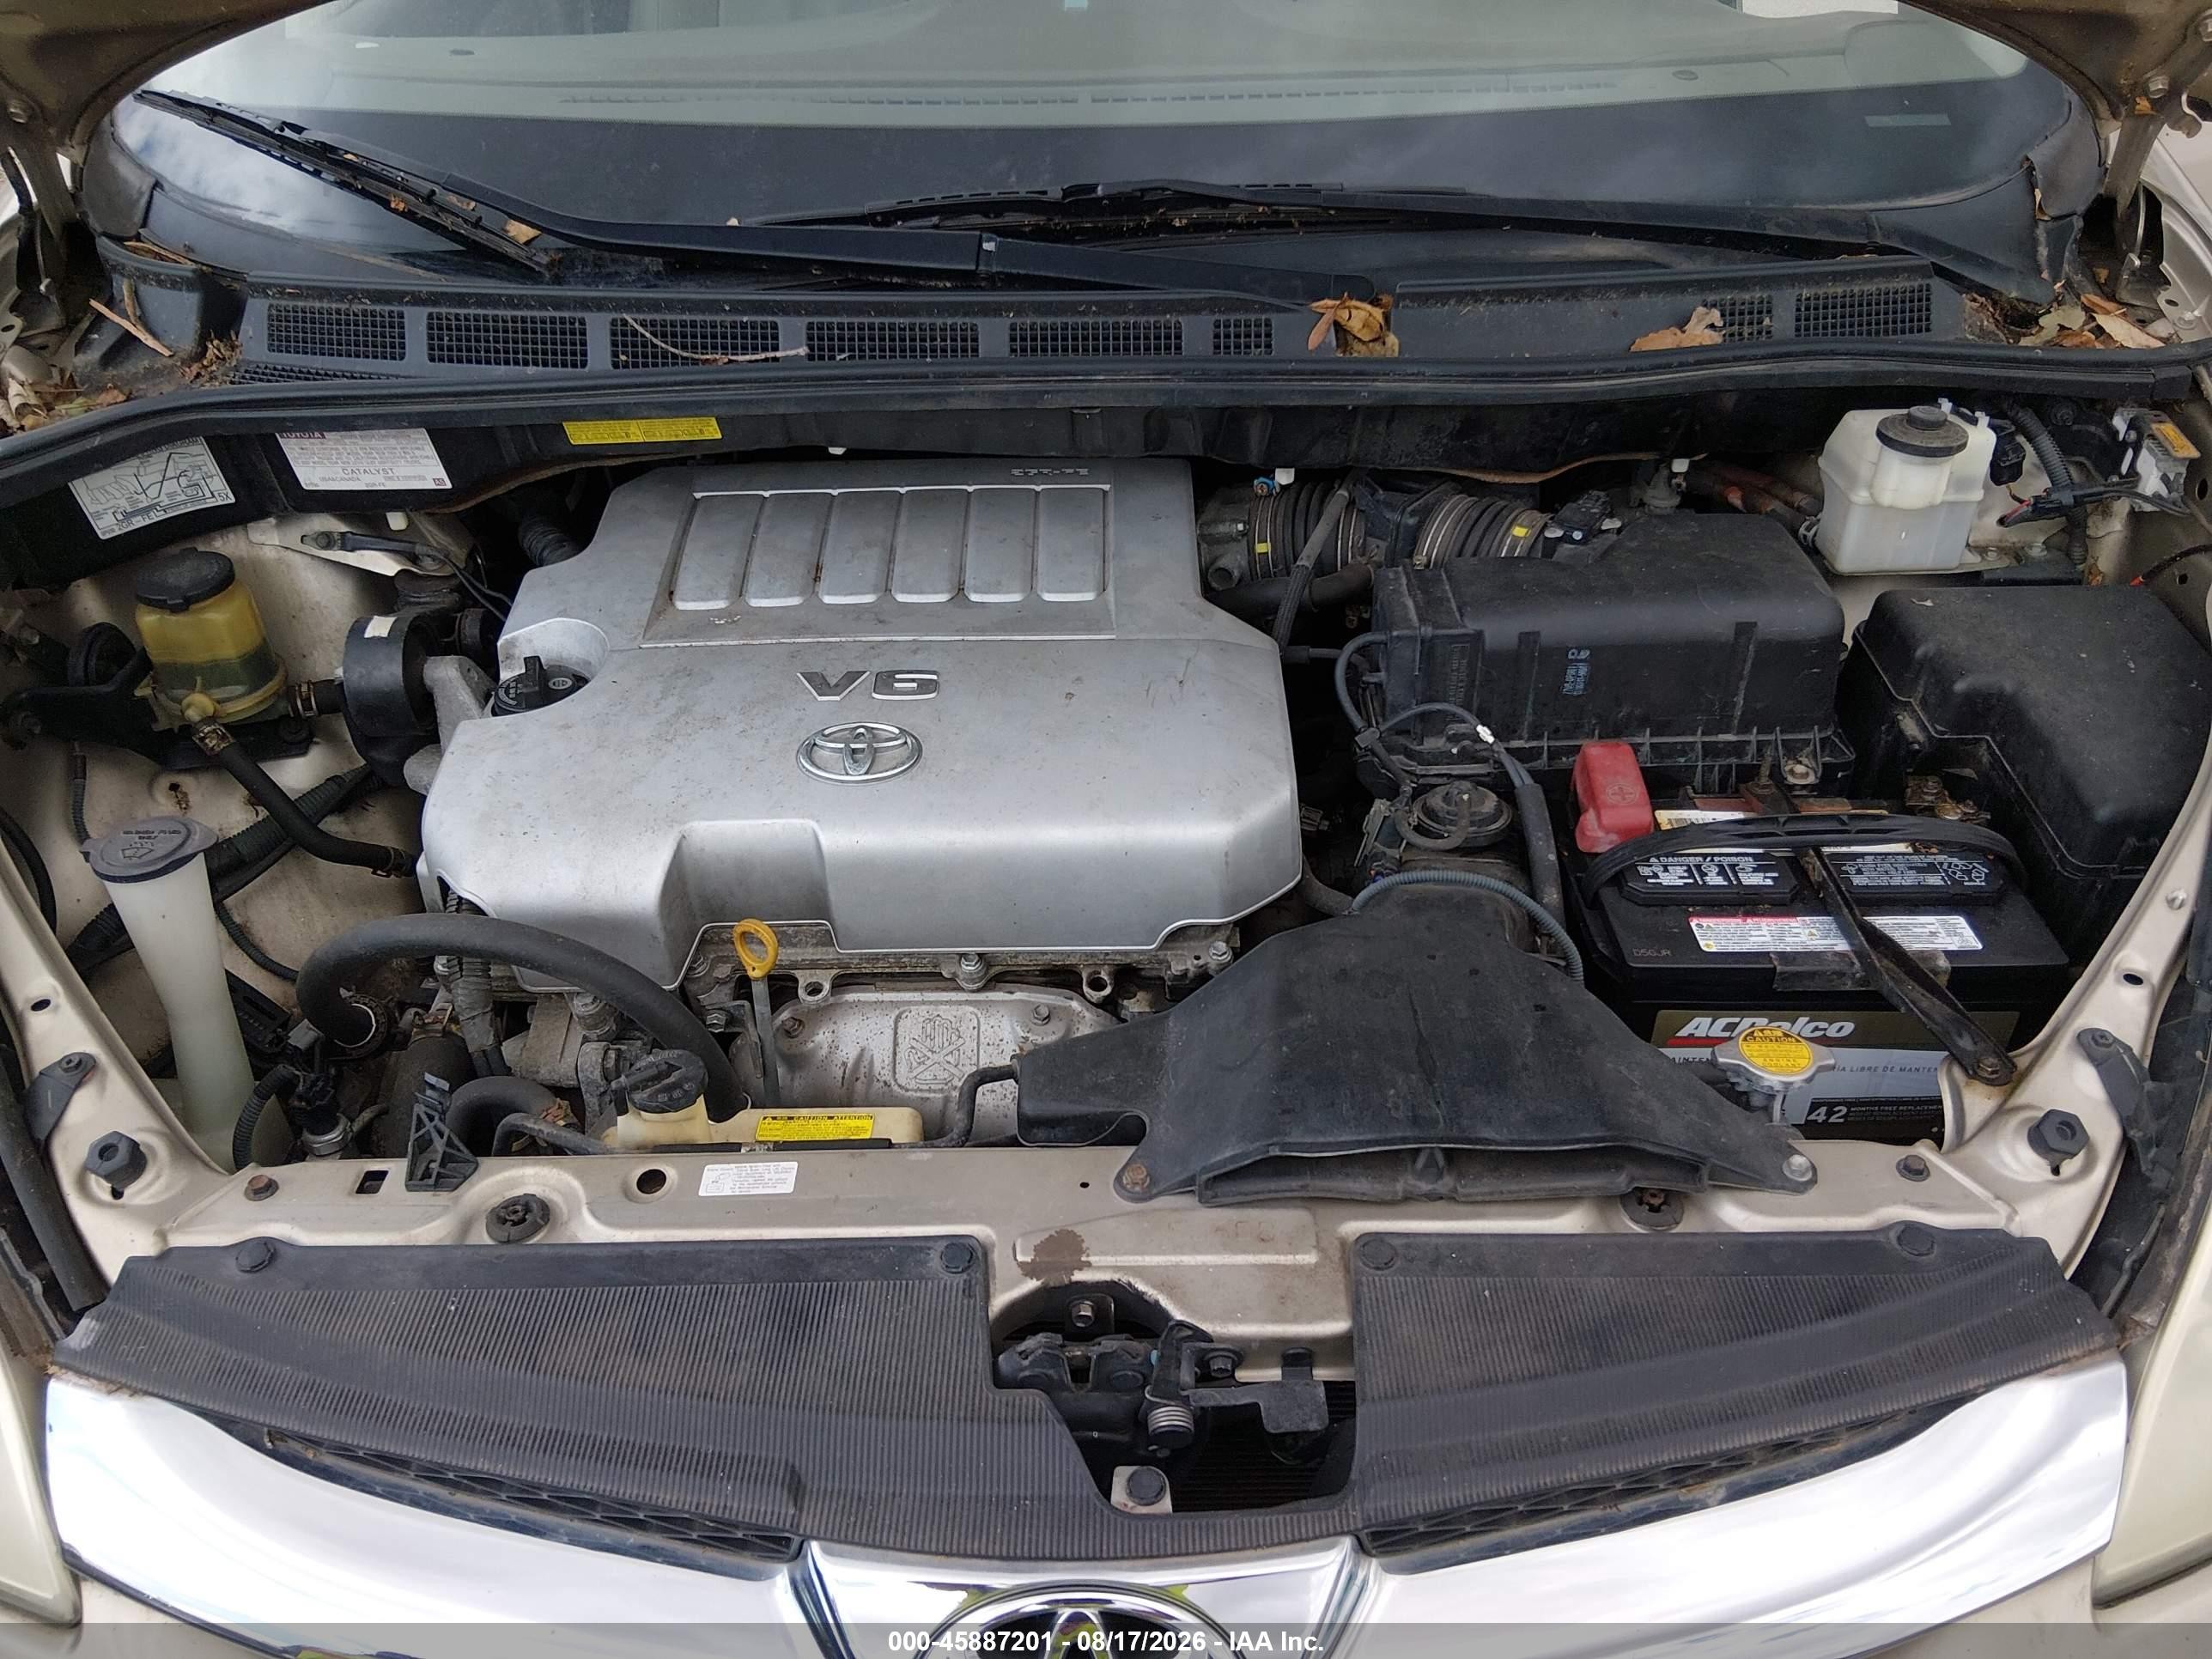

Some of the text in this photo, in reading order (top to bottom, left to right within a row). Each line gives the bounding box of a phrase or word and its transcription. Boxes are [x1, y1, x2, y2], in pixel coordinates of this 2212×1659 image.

[218, 490, 232, 502] 5X
[796, 670, 940, 702] V6
[1807, 1105, 1848, 1123] 42
